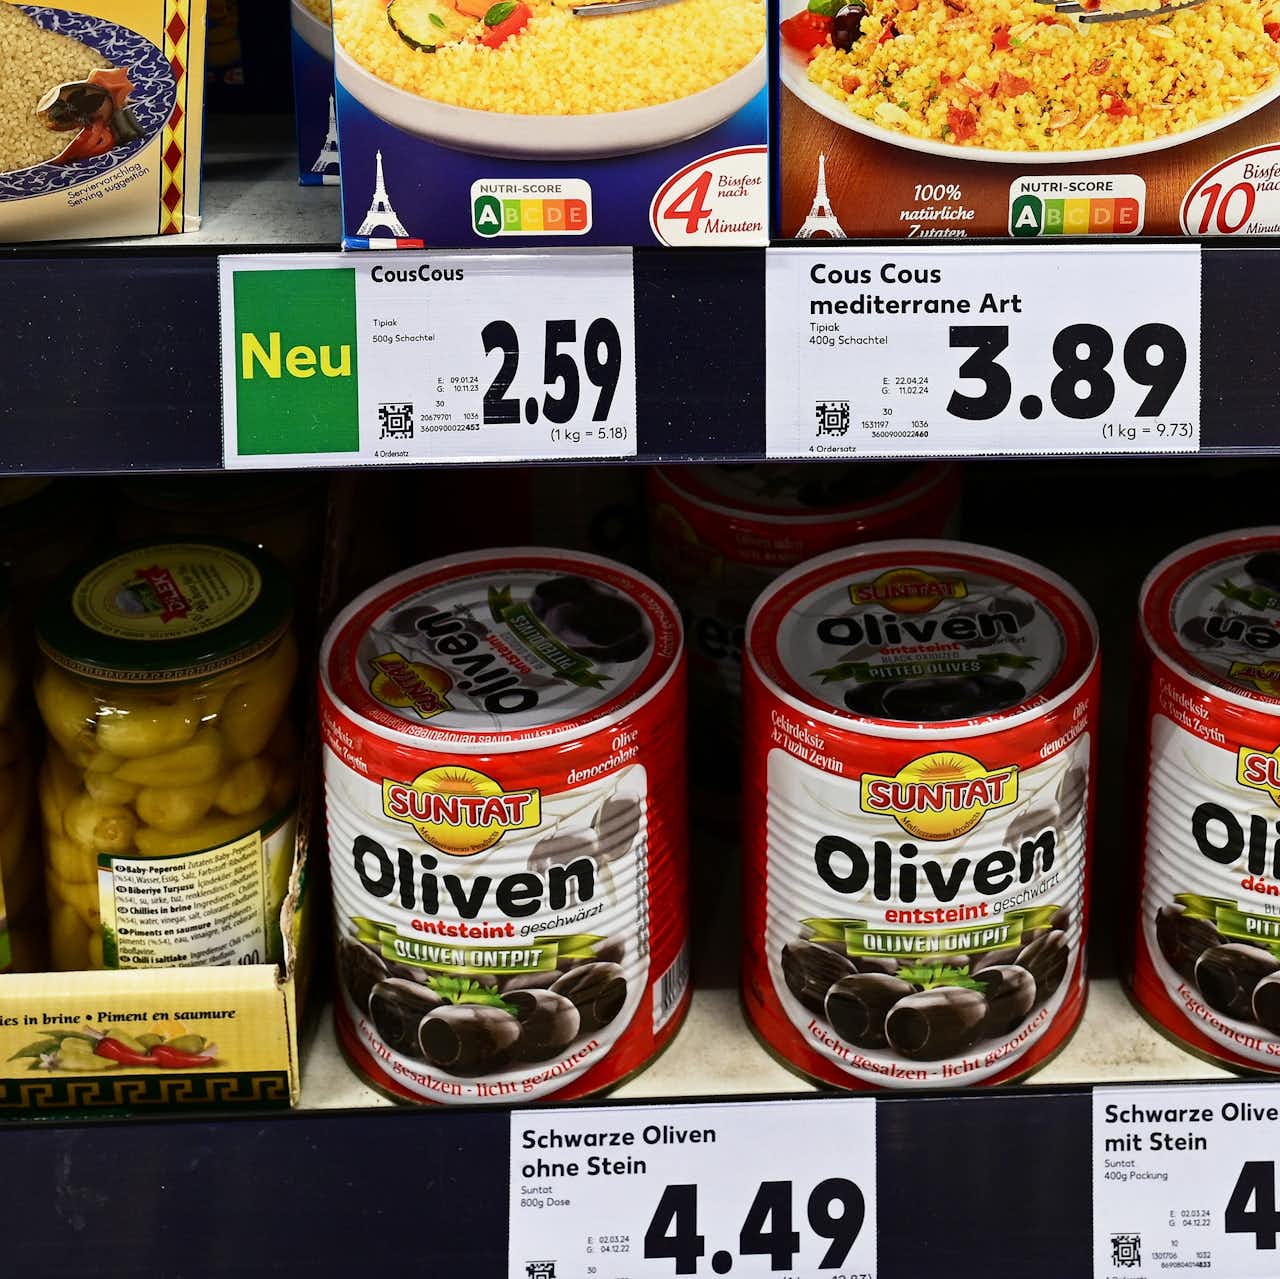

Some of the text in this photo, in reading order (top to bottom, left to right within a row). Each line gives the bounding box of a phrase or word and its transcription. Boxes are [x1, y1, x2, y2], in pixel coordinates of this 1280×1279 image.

[67, 167, 150, 208] Serving suggestion
[68, 162, 141, 199] Serviervorschlag
[480, 184, 562, 193] NUTRI-SCORE
[718, 188, 748, 198] nach
[913, 184, 961, 202] 100%
[900, 206, 975, 223] natürliche
[704, 218, 762, 234] Minuten
[810, 264, 941, 284] Cous Cous
[810, 294, 1022, 315] mediterrane Art
[373, 333, 435, 344] 500g Schachtel
[242, 332, 351, 379] Neu
[481, 318, 622, 425] 2.59
[947, 323, 1187, 420] 3.89
[1102, 423, 1114, 438] (1
[1118, 424, 1136, 439] kg
[1156, 423, 1193, 438] 9.73)
[412, 903, 604, 939] entsteint geschwärzt
[23, 1009, 236, 1025] in brine Piment en saumure
[808, 1007, 1050, 1081] leicht gesalzen licht gezouten
[1105, 1133, 1207, 1151] mit Stein
[522, 1157, 647, 1178] ohne Stein
[1104, 1171, 1168, 1181] 400g Packung
[644, 1177, 865, 1275] 4.49
